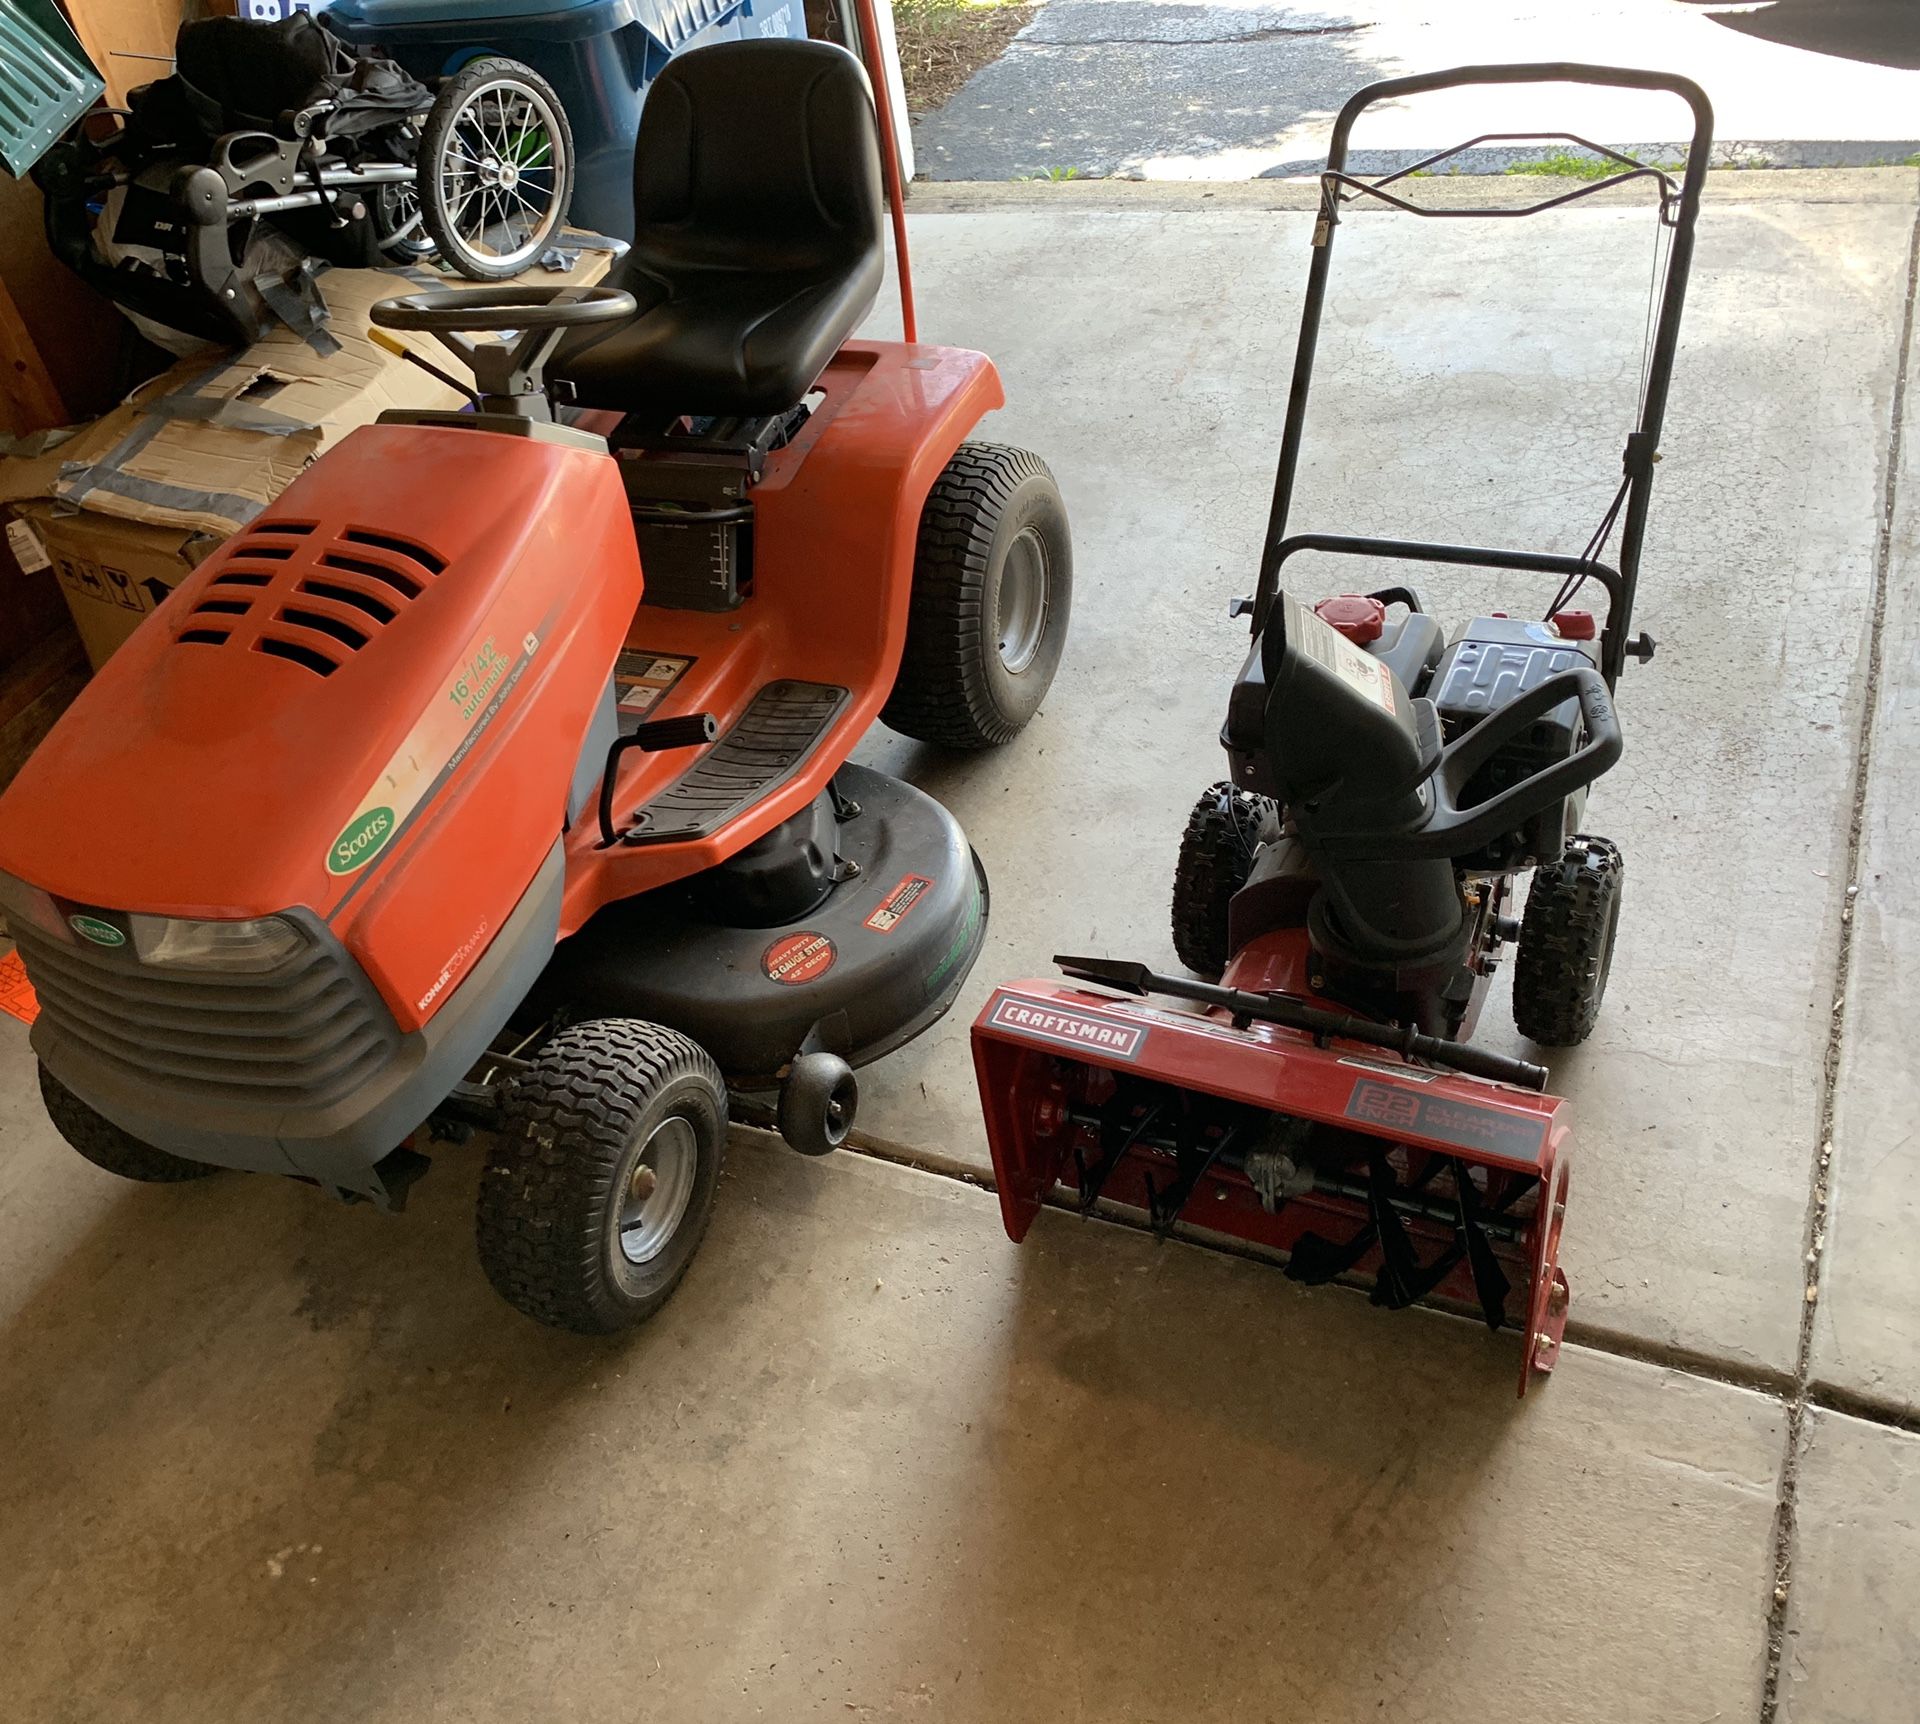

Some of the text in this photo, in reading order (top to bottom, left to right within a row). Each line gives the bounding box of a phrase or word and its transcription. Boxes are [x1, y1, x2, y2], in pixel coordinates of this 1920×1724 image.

[462, 655, 510, 721] automatic
[447, 713, 491, 771] Manufactured
[498, 681, 514, 706] John
[512, 659, 529, 684] Deere
[337, 814, 388, 866] Scotts
[418, 970, 451, 1010] KOHLER
[449, 921, 488, 973] COMMAND
[769, 937, 809, 967] HEAVY DUTY
[769, 936, 830, 980] 12 GAUGE STEEL
[805, 950, 829, 968] DECK
[1004, 1006, 1128, 1046] CRAFTSMAN
[1357, 1106, 1415, 1127] INCH
[1360, 1087, 1413, 1111] 22
